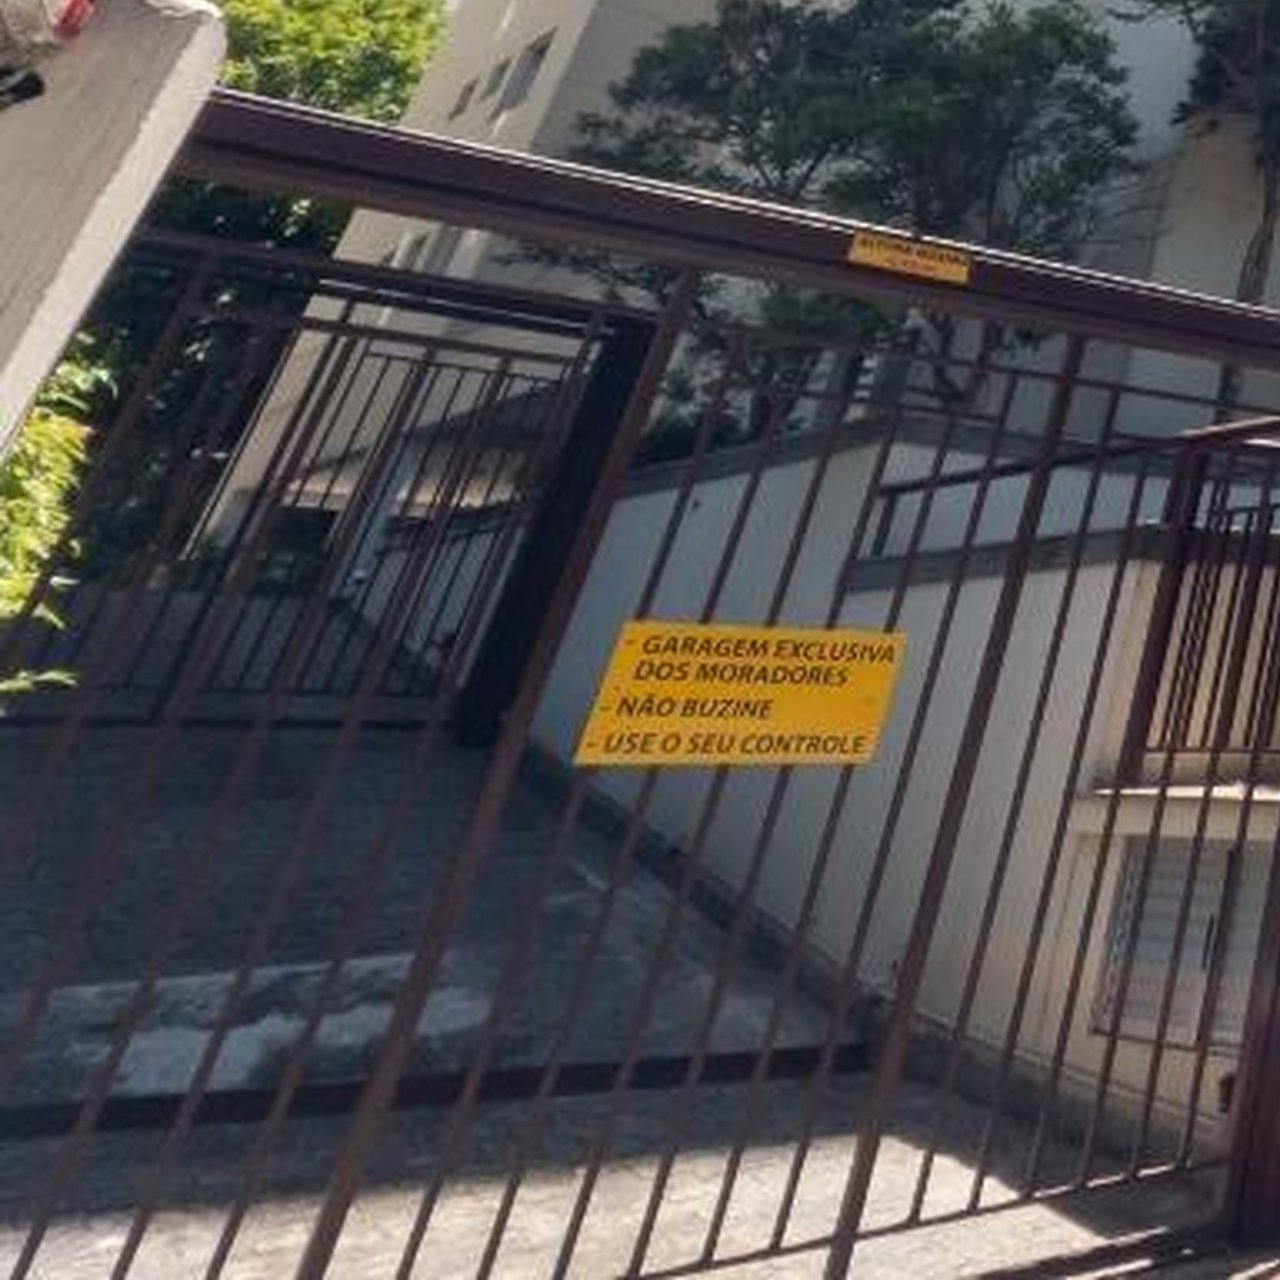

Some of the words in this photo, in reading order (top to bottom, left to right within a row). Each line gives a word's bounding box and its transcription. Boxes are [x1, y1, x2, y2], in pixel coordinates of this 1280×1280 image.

[642, 635, 768, 657] GARAGEM
[773, 638, 895, 663] EXCLUSIVA
[634, 660, 690, 681] DOS
[695, 662, 849, 686] MORADORES
[616, 694, 676, 717] NÃO
[680, 699, 774, 718] BUZINE
[603, 732, 659, 754] USE
[661, 733, 682, 754] O
[685, 733, 735, 754] SEU
[739, 733, 868, 754] CONTROLE
